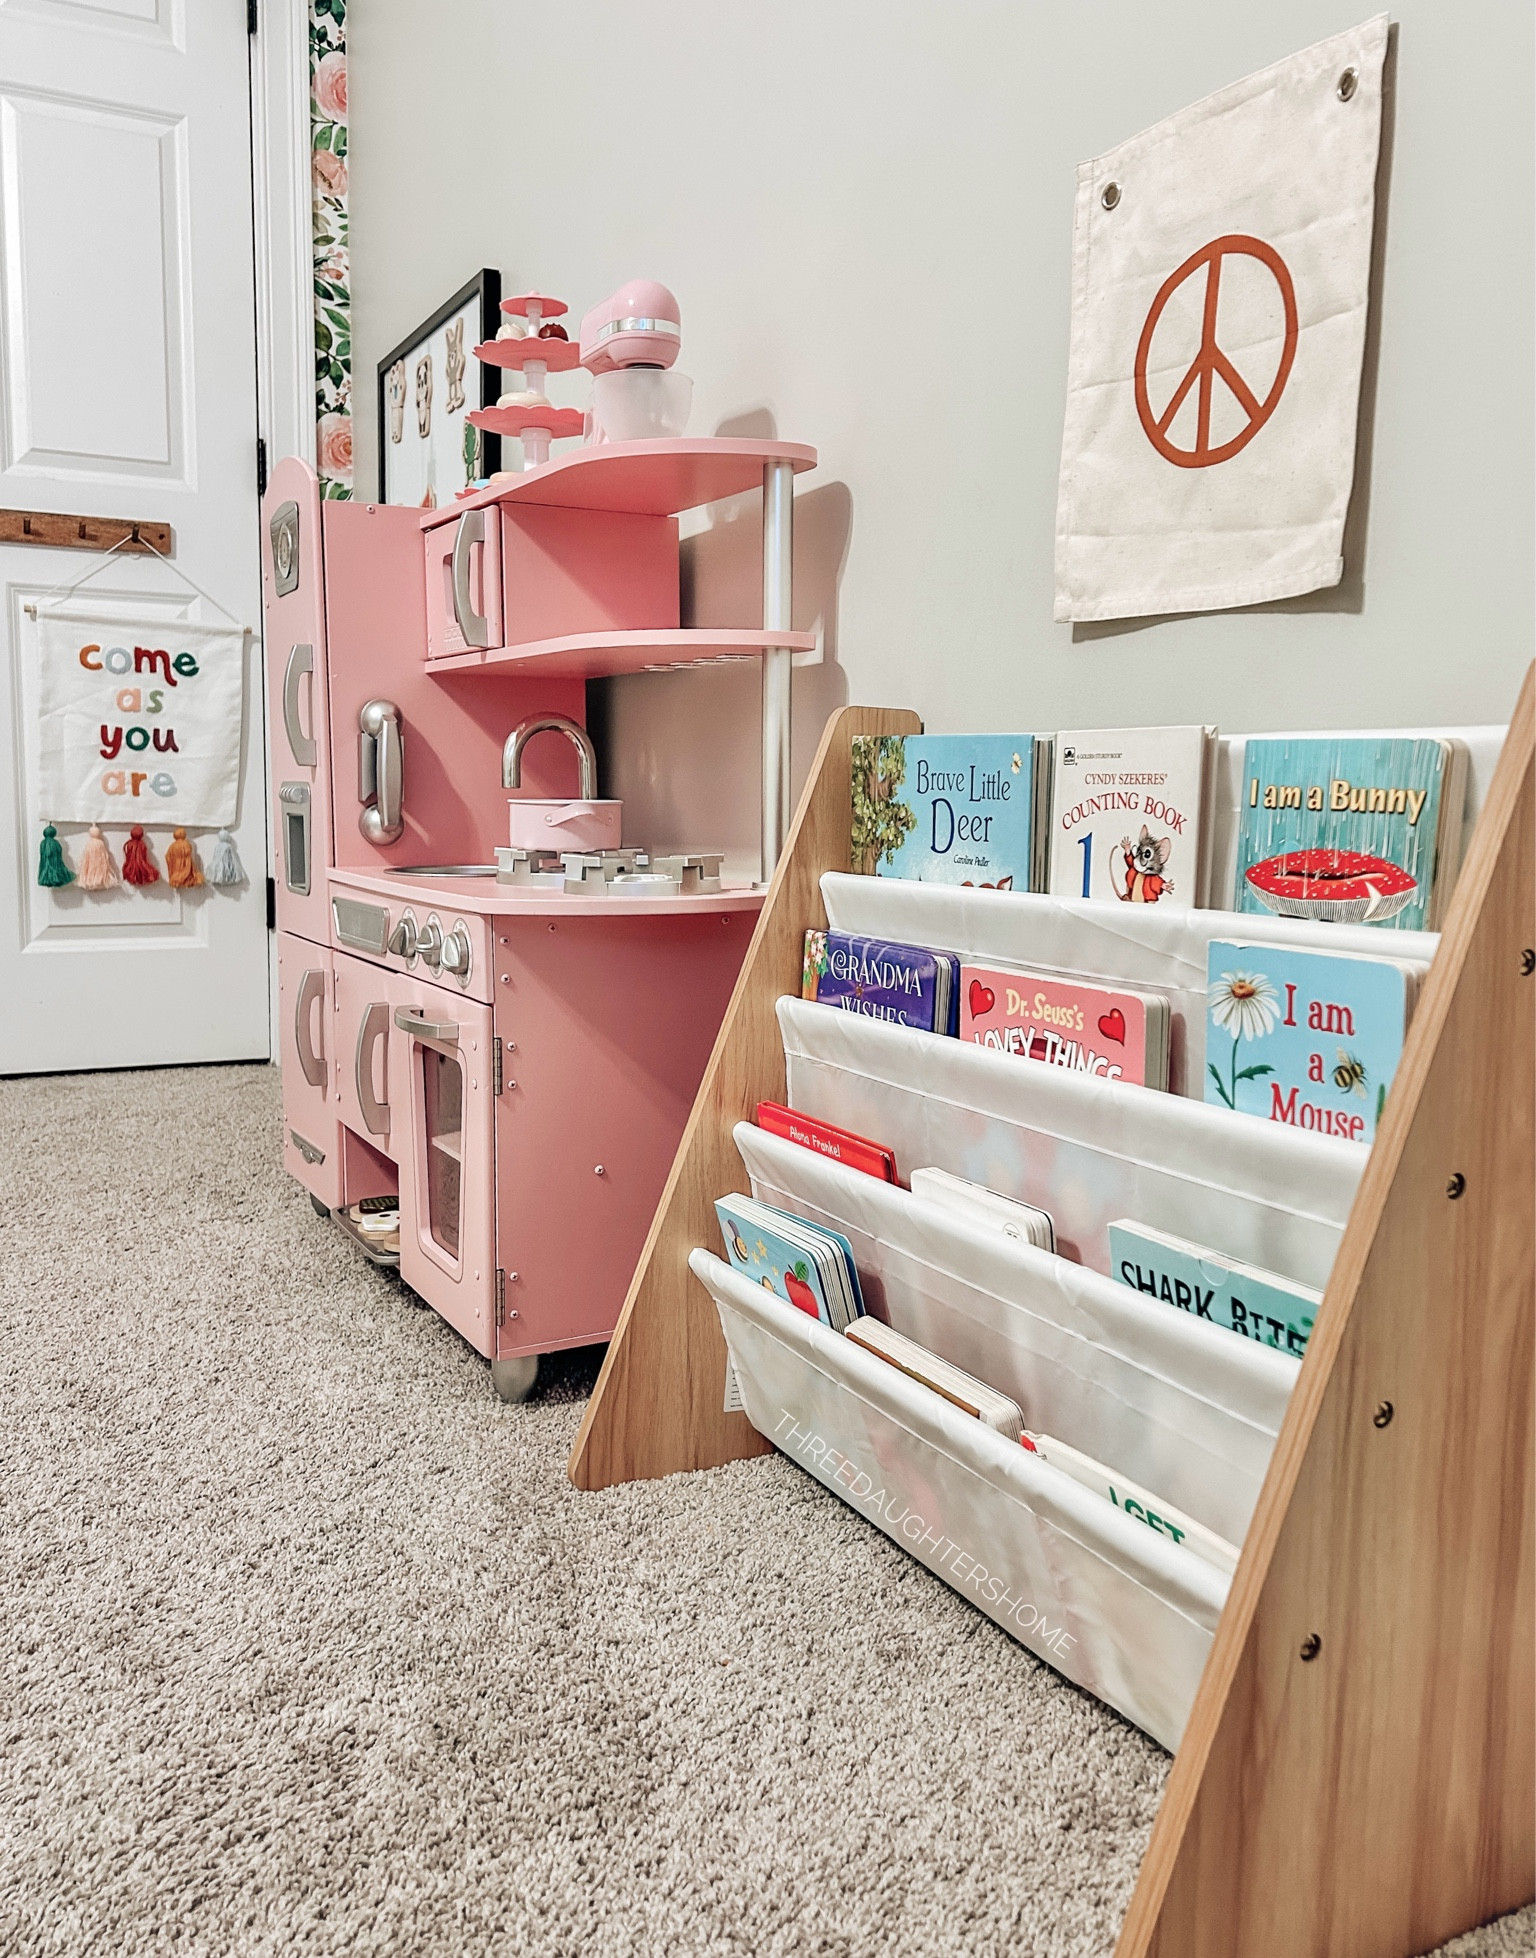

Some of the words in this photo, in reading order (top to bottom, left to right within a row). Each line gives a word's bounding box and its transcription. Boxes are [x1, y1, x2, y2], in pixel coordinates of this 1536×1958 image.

[78, 644, 200, 687] come
[116, 687, 164, 714] as
[99, 724, 179, 760] you
[101, 770, 177, 797] are
[916, 759, 965, 795] Brave
[968, 765, 1011, 802] Little
[1084, 773, 1117, 785] CYNDY
[1118, 773, 1168, 785] SZEKERES'
[1062, 791, 1139, 830] COUNTING
[1143, 795, 1188, 836] BOOK
[1250, 778, 1260, 807] I
[1263, 785, 1303, 809] am
[1307, 785, 1324, 811] a
[1330, 778, 1428, 826] Bunny
[930, 797, 993, 854] Deer
[1077, 832, 1093, 899] 1
[831, 949, 923, 998] GRANDMA
[840, 995, 908, 1027] WISHES
[1006, 988, 1030, 1018] Dr.
[1031, 992, 1085, 1032] Seuss's
[1283, 983, 1297, 1027] I
[1308, 1000, 1356, 1036] am
[1308, 1053, 1325, 1084] a
[1268, 1082, 1365, 1142] Mouse
[811, 1134, 841, 1158] Frankel
[1120, 1260, 1215, 1321] SHARK
